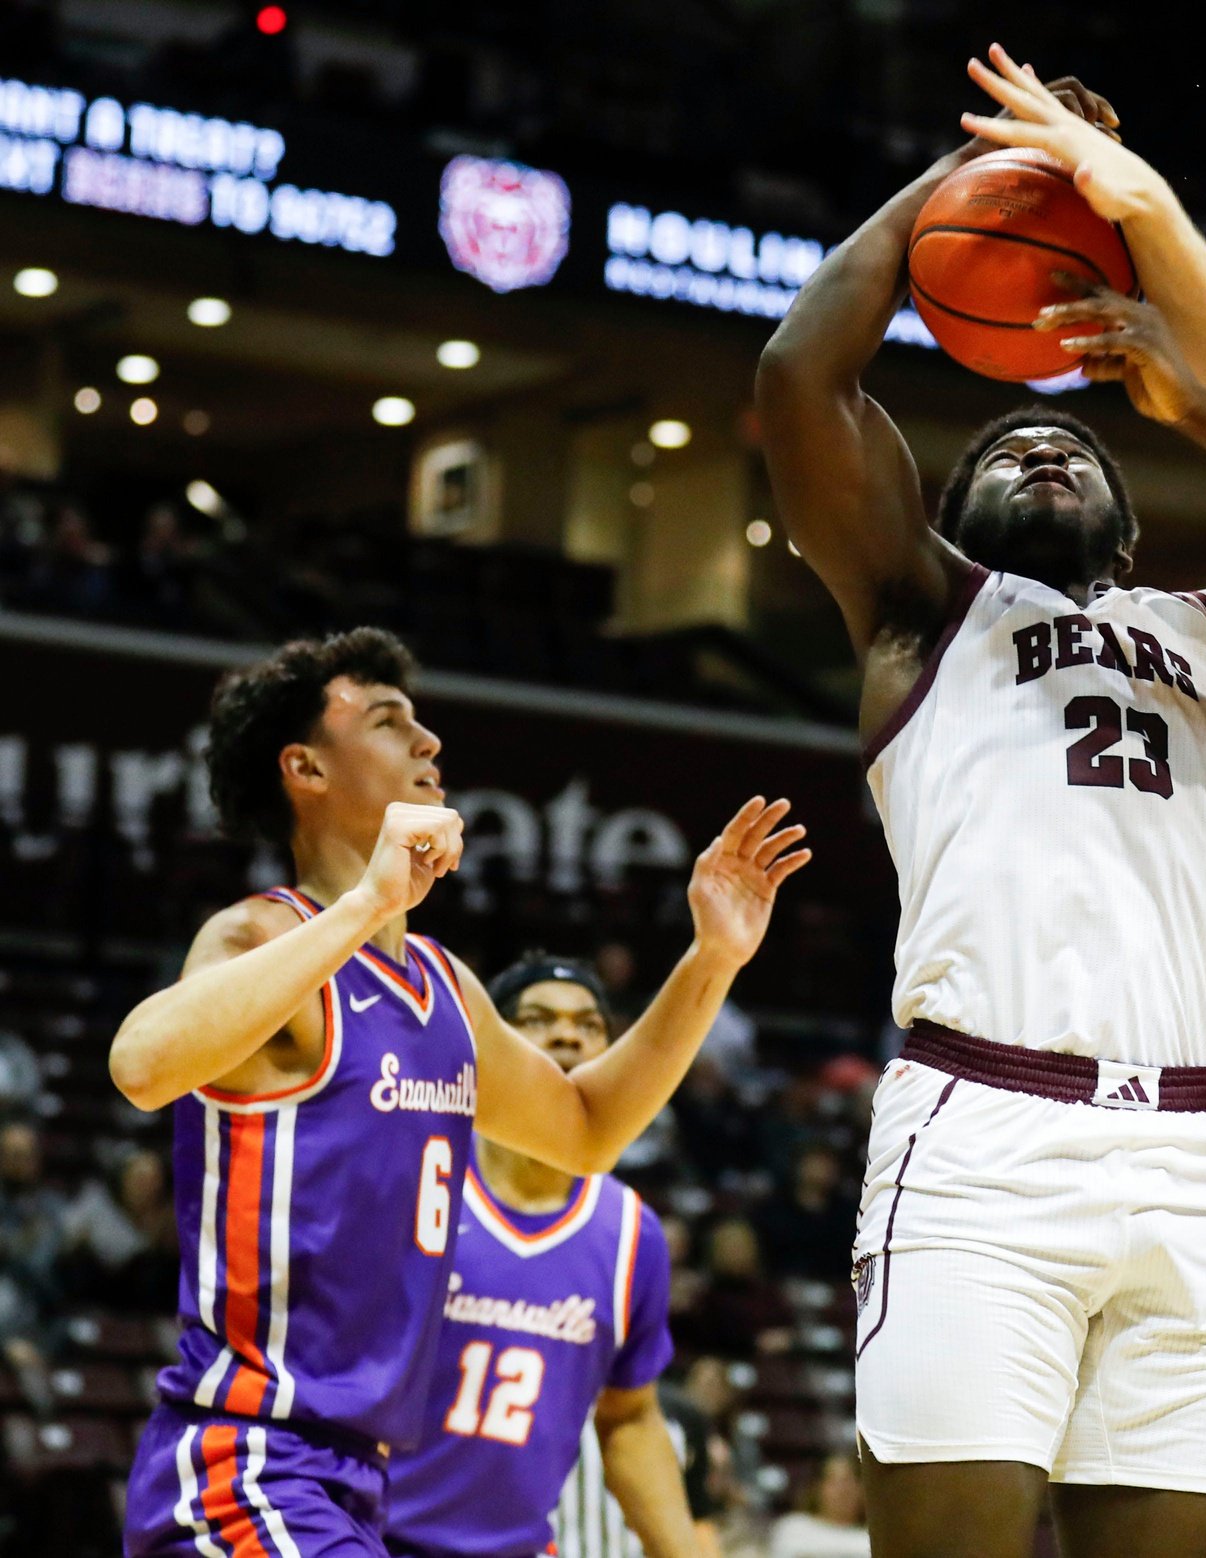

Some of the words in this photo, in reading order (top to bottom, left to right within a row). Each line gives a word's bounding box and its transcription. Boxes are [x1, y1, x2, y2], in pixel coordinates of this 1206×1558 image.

[1012, 614, 1198, 701] BEARS
[1063, 695, 1174, 801] 23
[438, 772, 691, 895] ate
[370, 1051, 477, 1117] Evansvill
[413, 1136, 452, 1257] 6
[443, 1339, 545, 1447] 12
